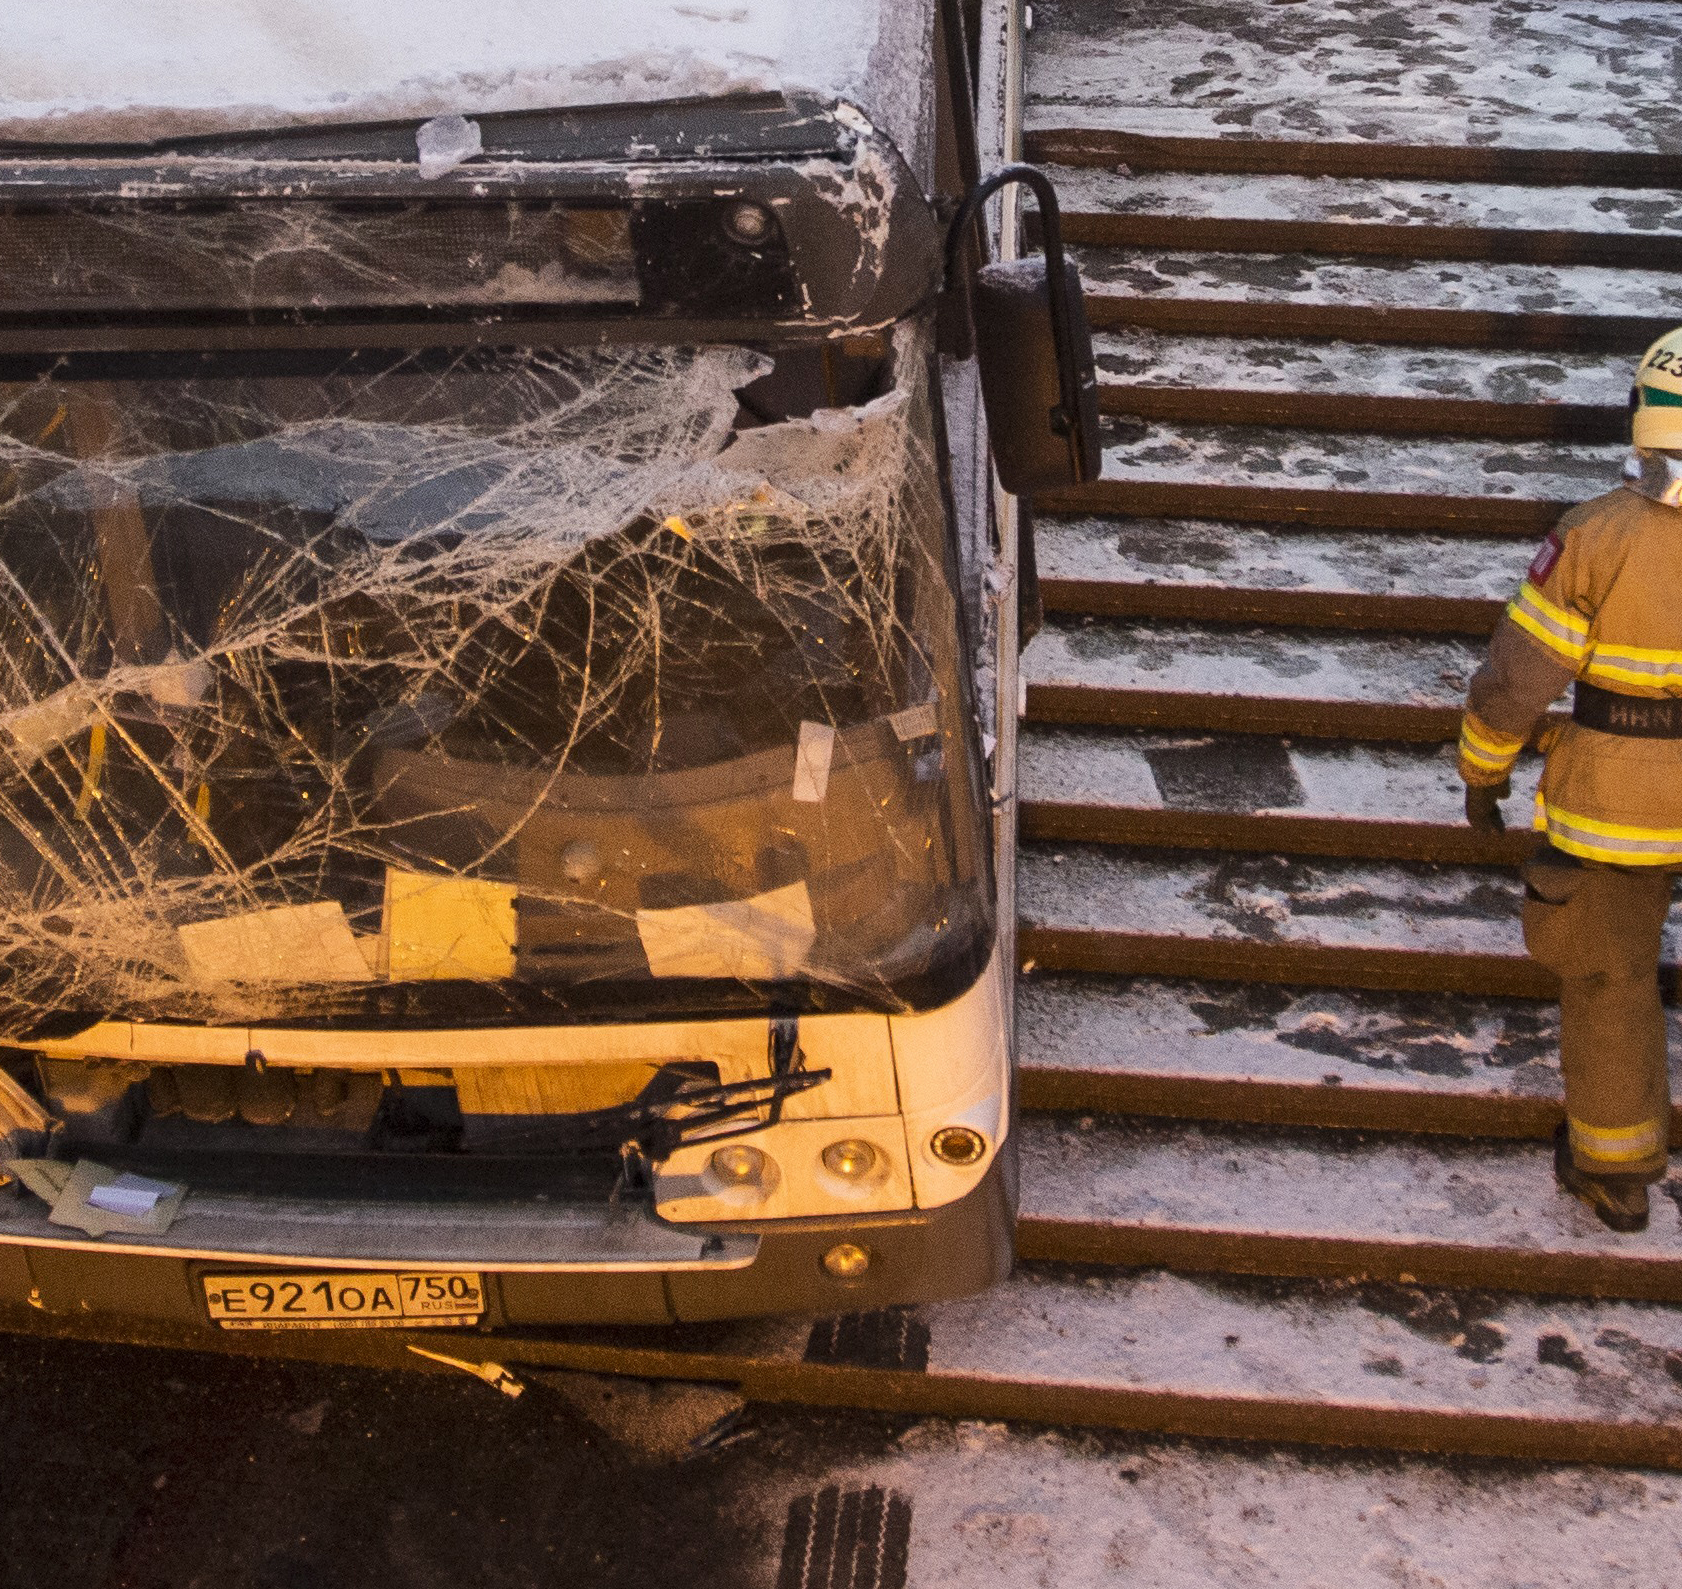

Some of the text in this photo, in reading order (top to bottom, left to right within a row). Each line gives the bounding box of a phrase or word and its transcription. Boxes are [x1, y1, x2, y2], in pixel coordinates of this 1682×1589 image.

[221, 1275, 469, 1314] Е921ОА 750
[421, 1301, 453, 1310] RUS
